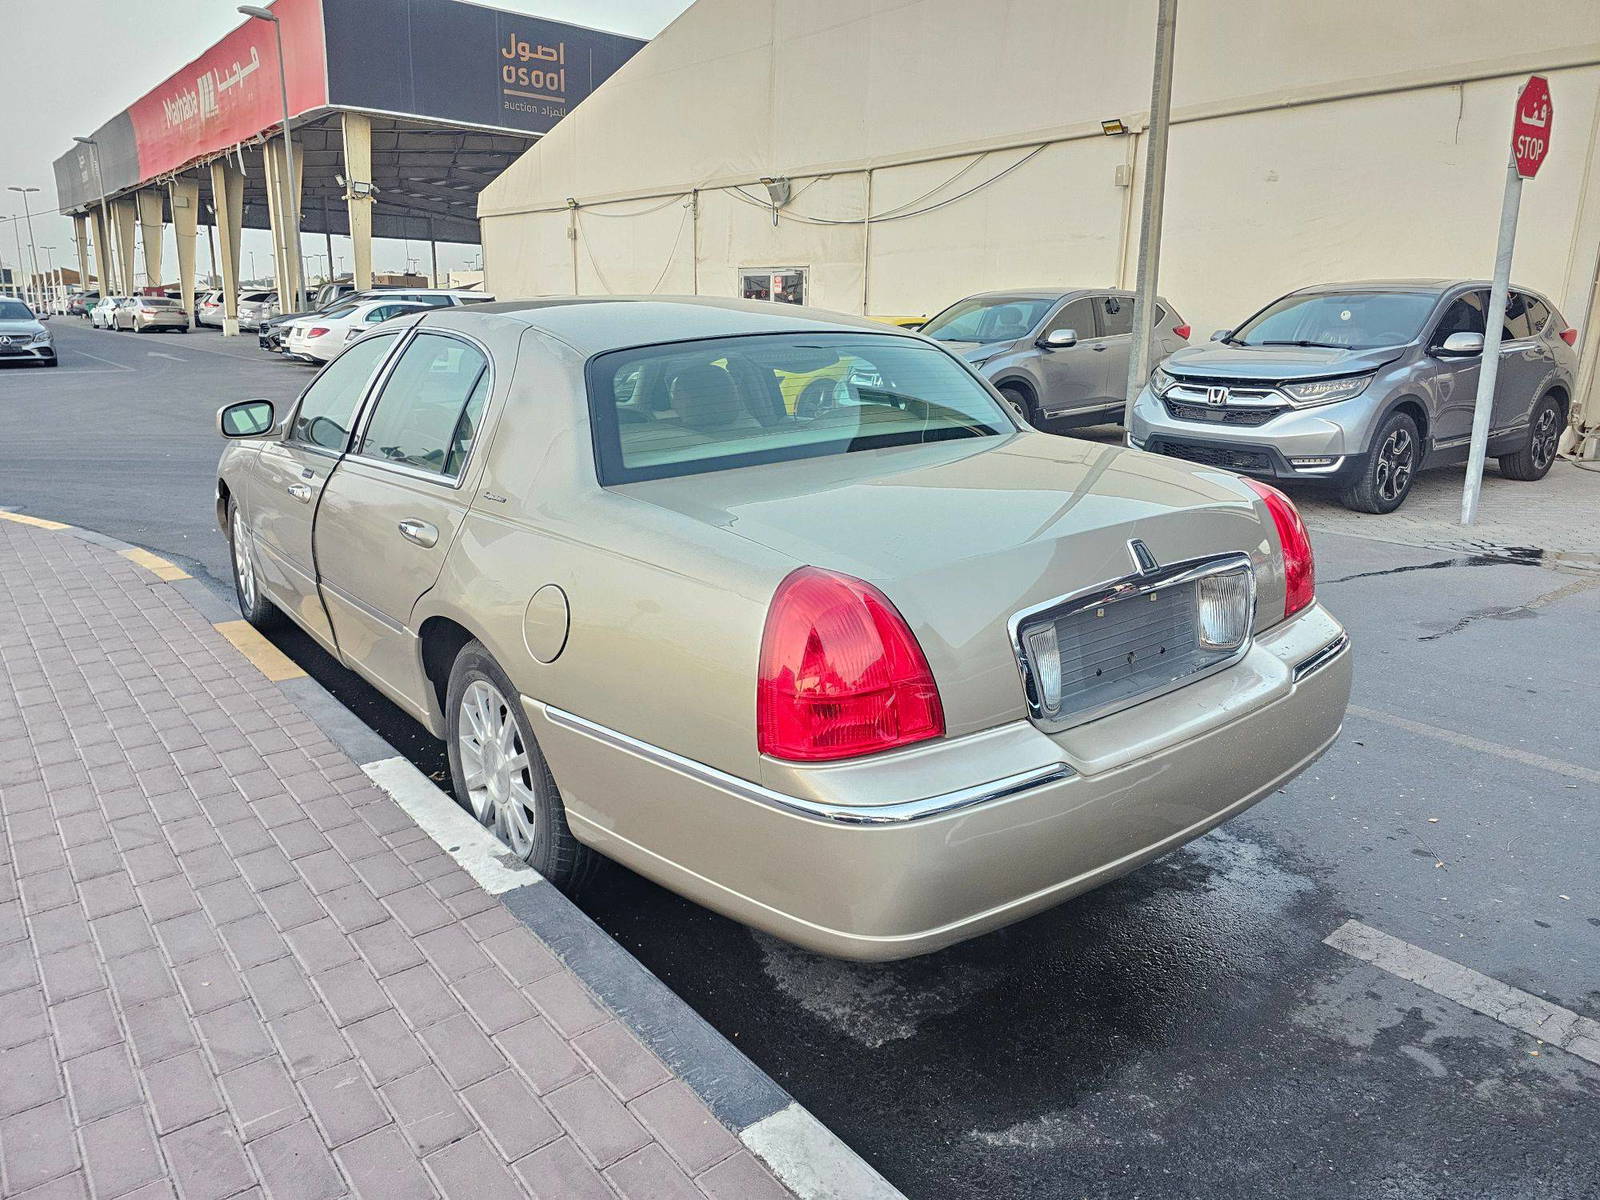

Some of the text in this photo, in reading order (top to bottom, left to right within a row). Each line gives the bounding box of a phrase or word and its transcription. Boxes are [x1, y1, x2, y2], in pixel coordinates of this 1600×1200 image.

[502, 32, 565, 64] اصول
[504, 101, 538, 113] auction
[1521, 94, 1548, 128] قف
[1516, 135, 1544, 161] STOP
